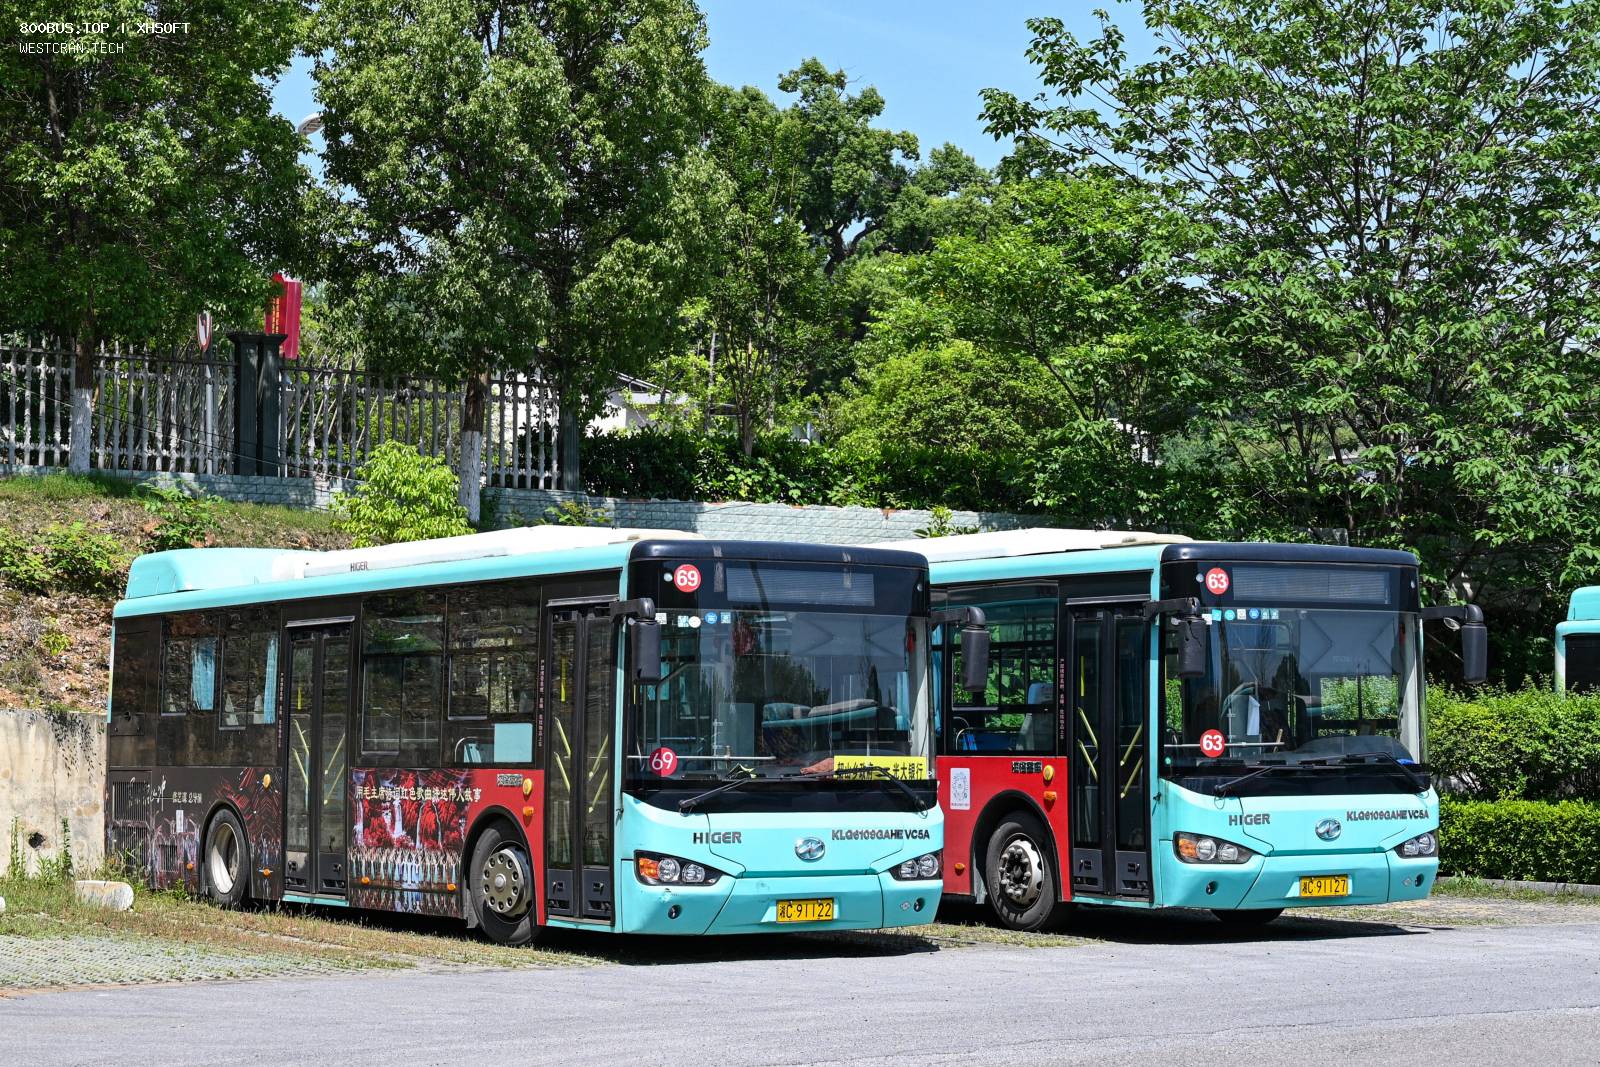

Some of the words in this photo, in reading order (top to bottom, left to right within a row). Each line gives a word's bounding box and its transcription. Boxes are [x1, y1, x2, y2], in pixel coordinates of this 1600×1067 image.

[350, 560, 369, 572] HIGER
[676, 569, 698, 587] 69
[1208, 573, 1227, 589] 63
[1202, 734, 1223, 751] 63
[651, 752, 673, 770] 69
[1229, 813, 1271, 826] HIGER
[693, 831, 742, 844] HIGER
